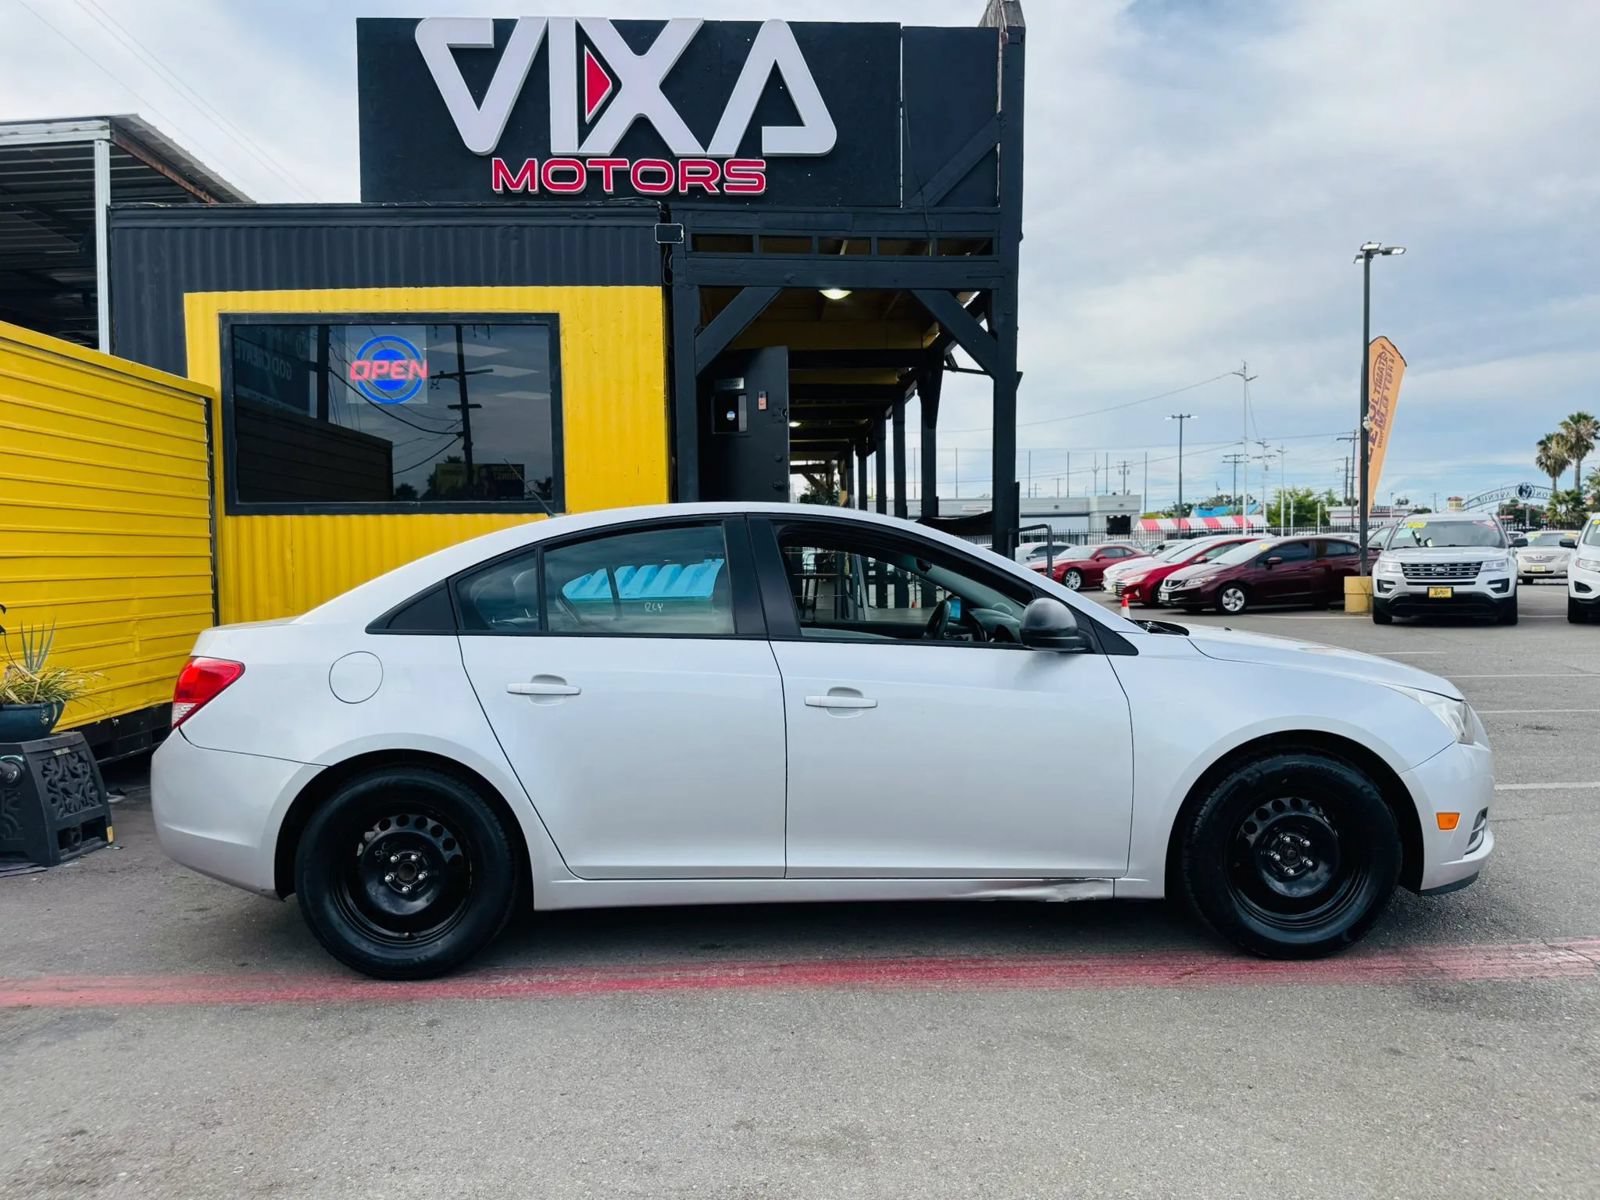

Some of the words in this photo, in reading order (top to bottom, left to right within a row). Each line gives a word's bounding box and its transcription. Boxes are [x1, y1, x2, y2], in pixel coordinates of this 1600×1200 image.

[415, 16, 837, 157] VIXA
[492, 157, 767, 195] MOTORS
[350, 359, 428, 380] OPEN
